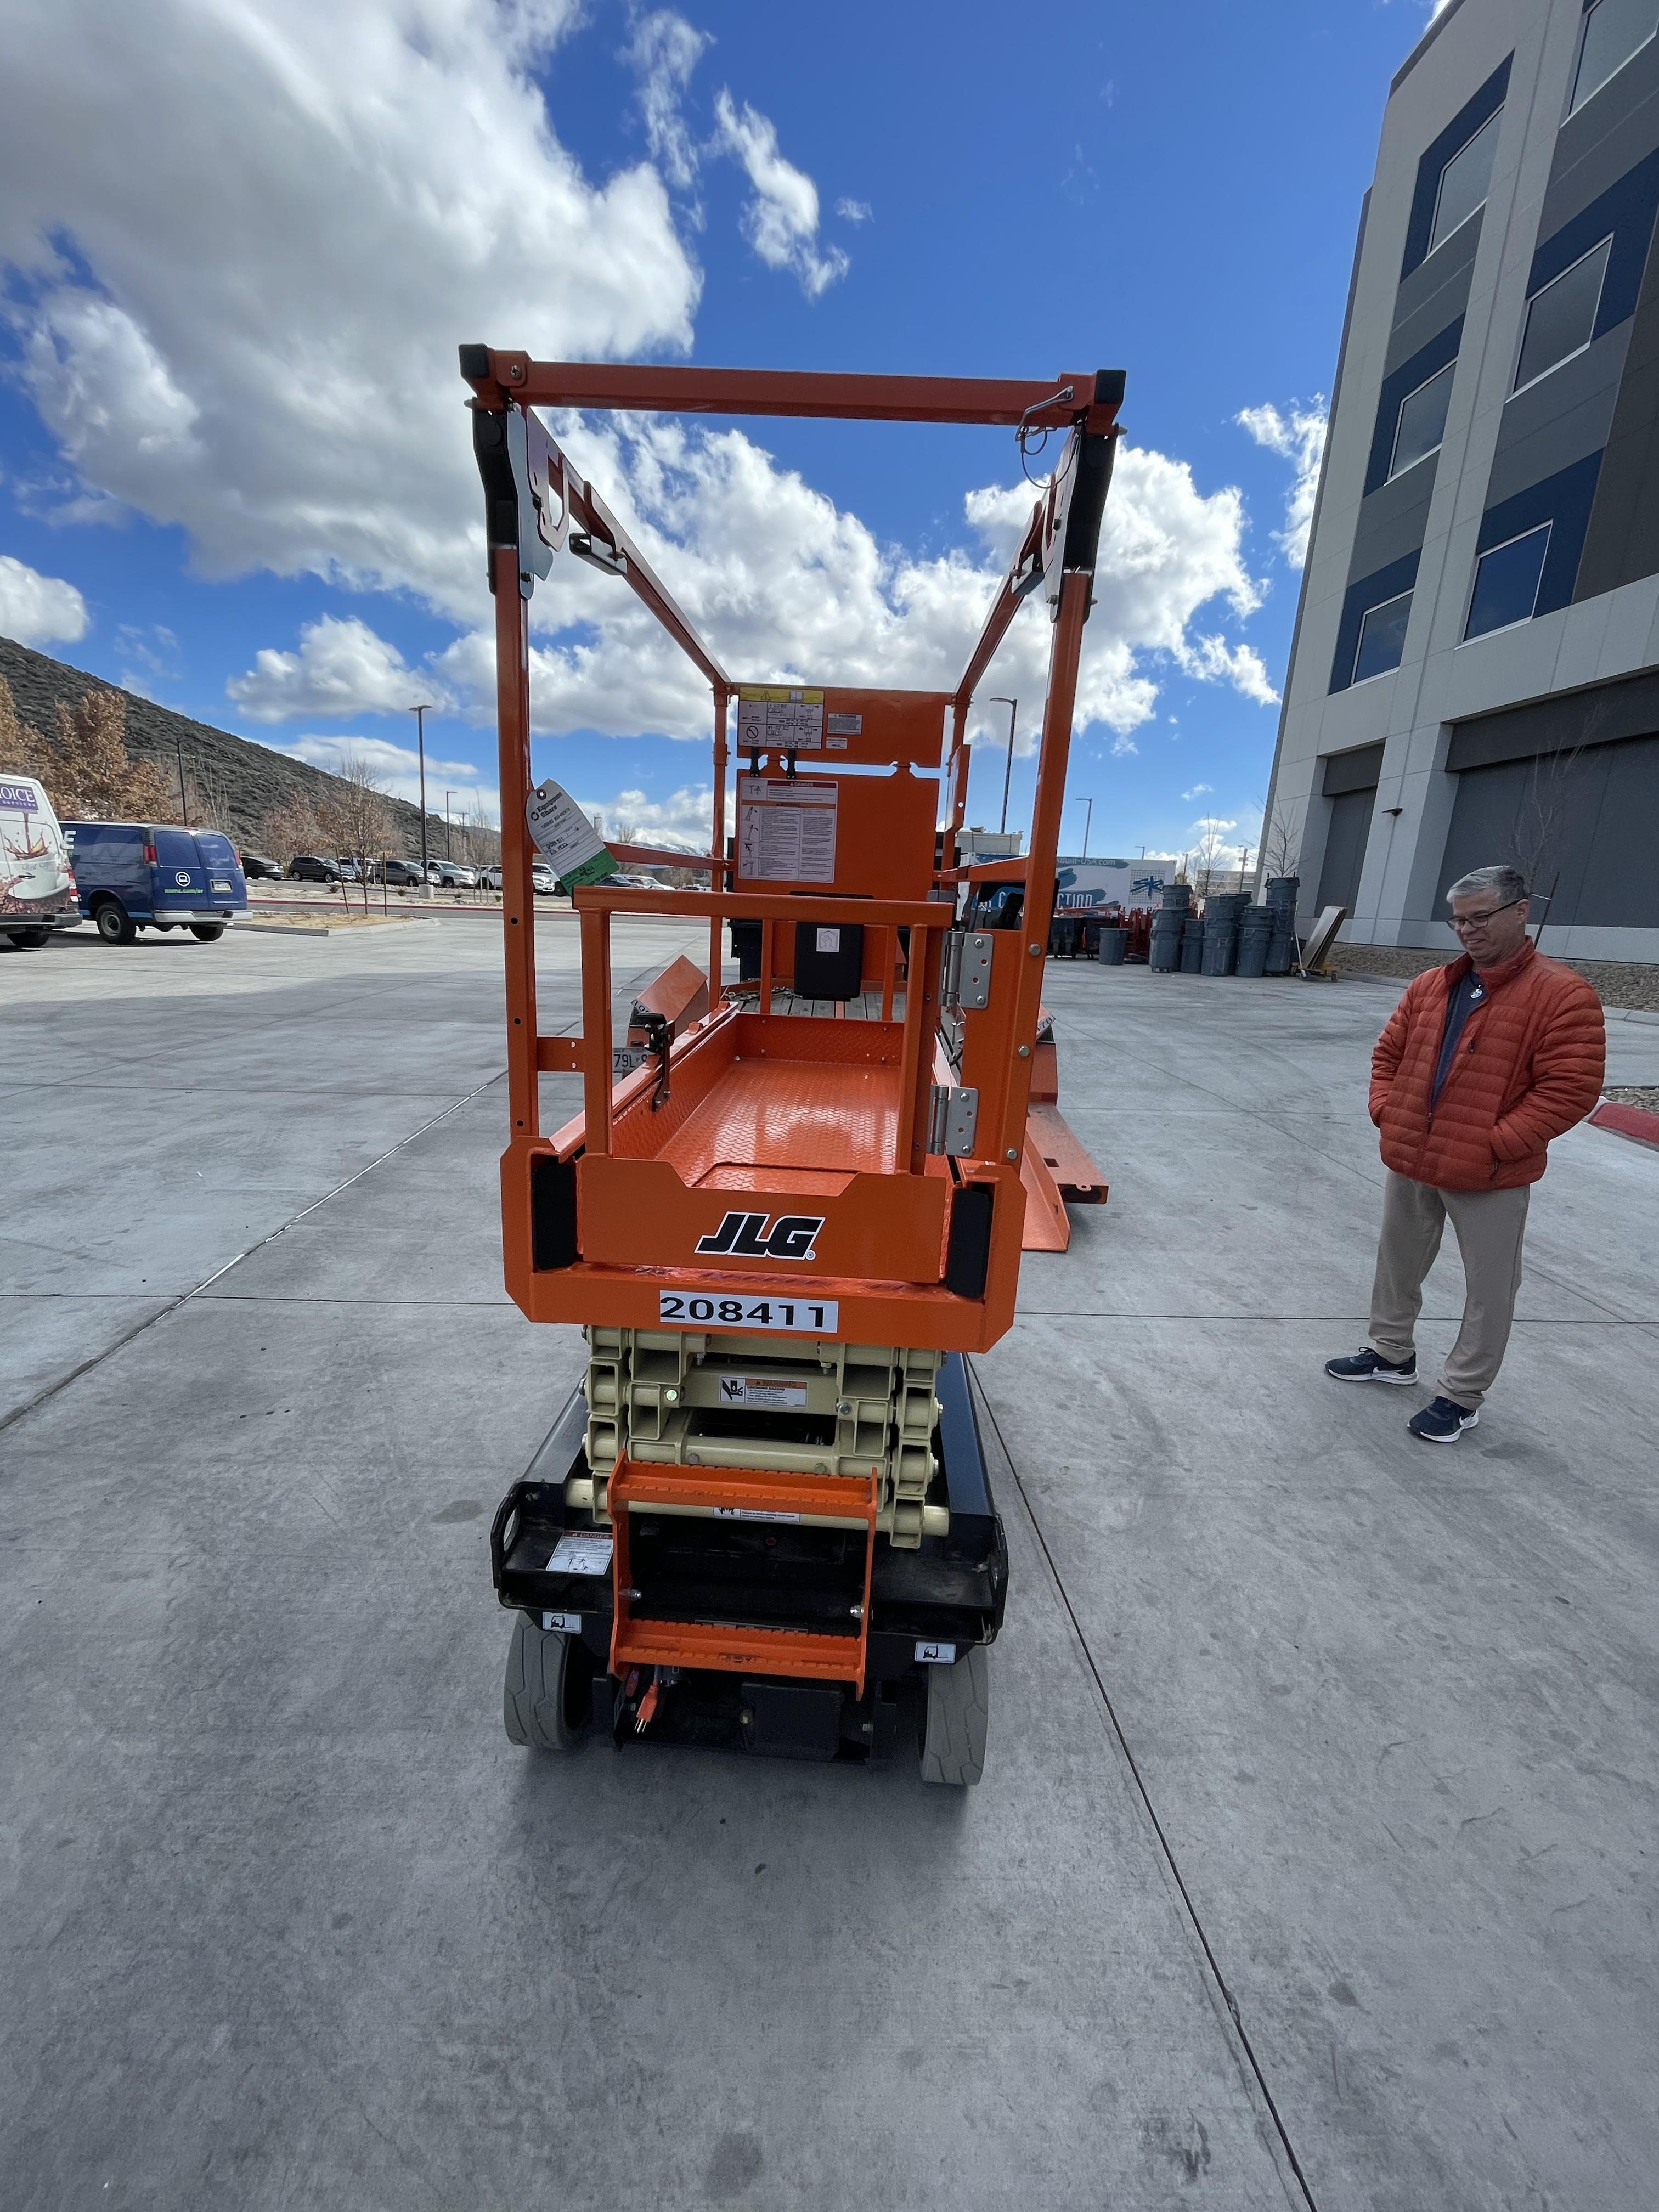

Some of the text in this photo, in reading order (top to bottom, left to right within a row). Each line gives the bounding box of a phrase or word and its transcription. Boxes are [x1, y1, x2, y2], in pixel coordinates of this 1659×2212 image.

[0, 787, 35, 802] OICE
[540, 805, 557, 818] Share
[694, 1211, 826, 1260] JLG
[660, 1297, 824, 1323] 208411
